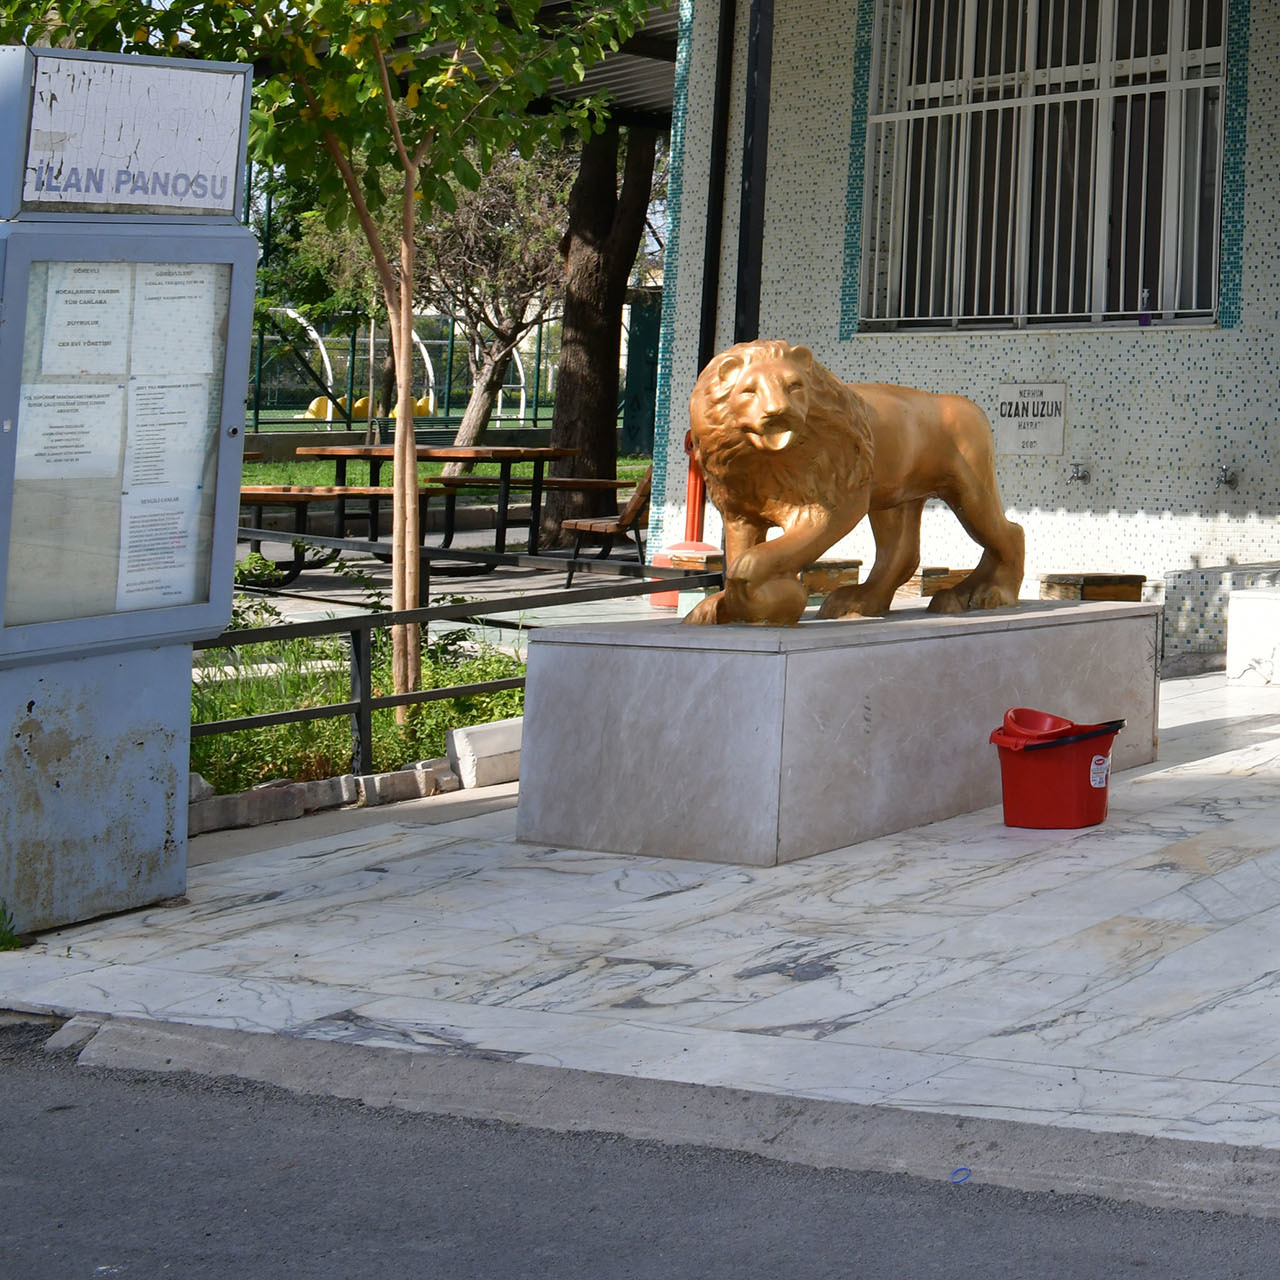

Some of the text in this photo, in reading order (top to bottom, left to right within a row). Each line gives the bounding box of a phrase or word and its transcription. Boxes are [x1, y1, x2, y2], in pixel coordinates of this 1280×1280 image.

[34, 159, 228, 201] İLAN PANOSU
[1000, 401, 1062, 418] OZAN UZUN
